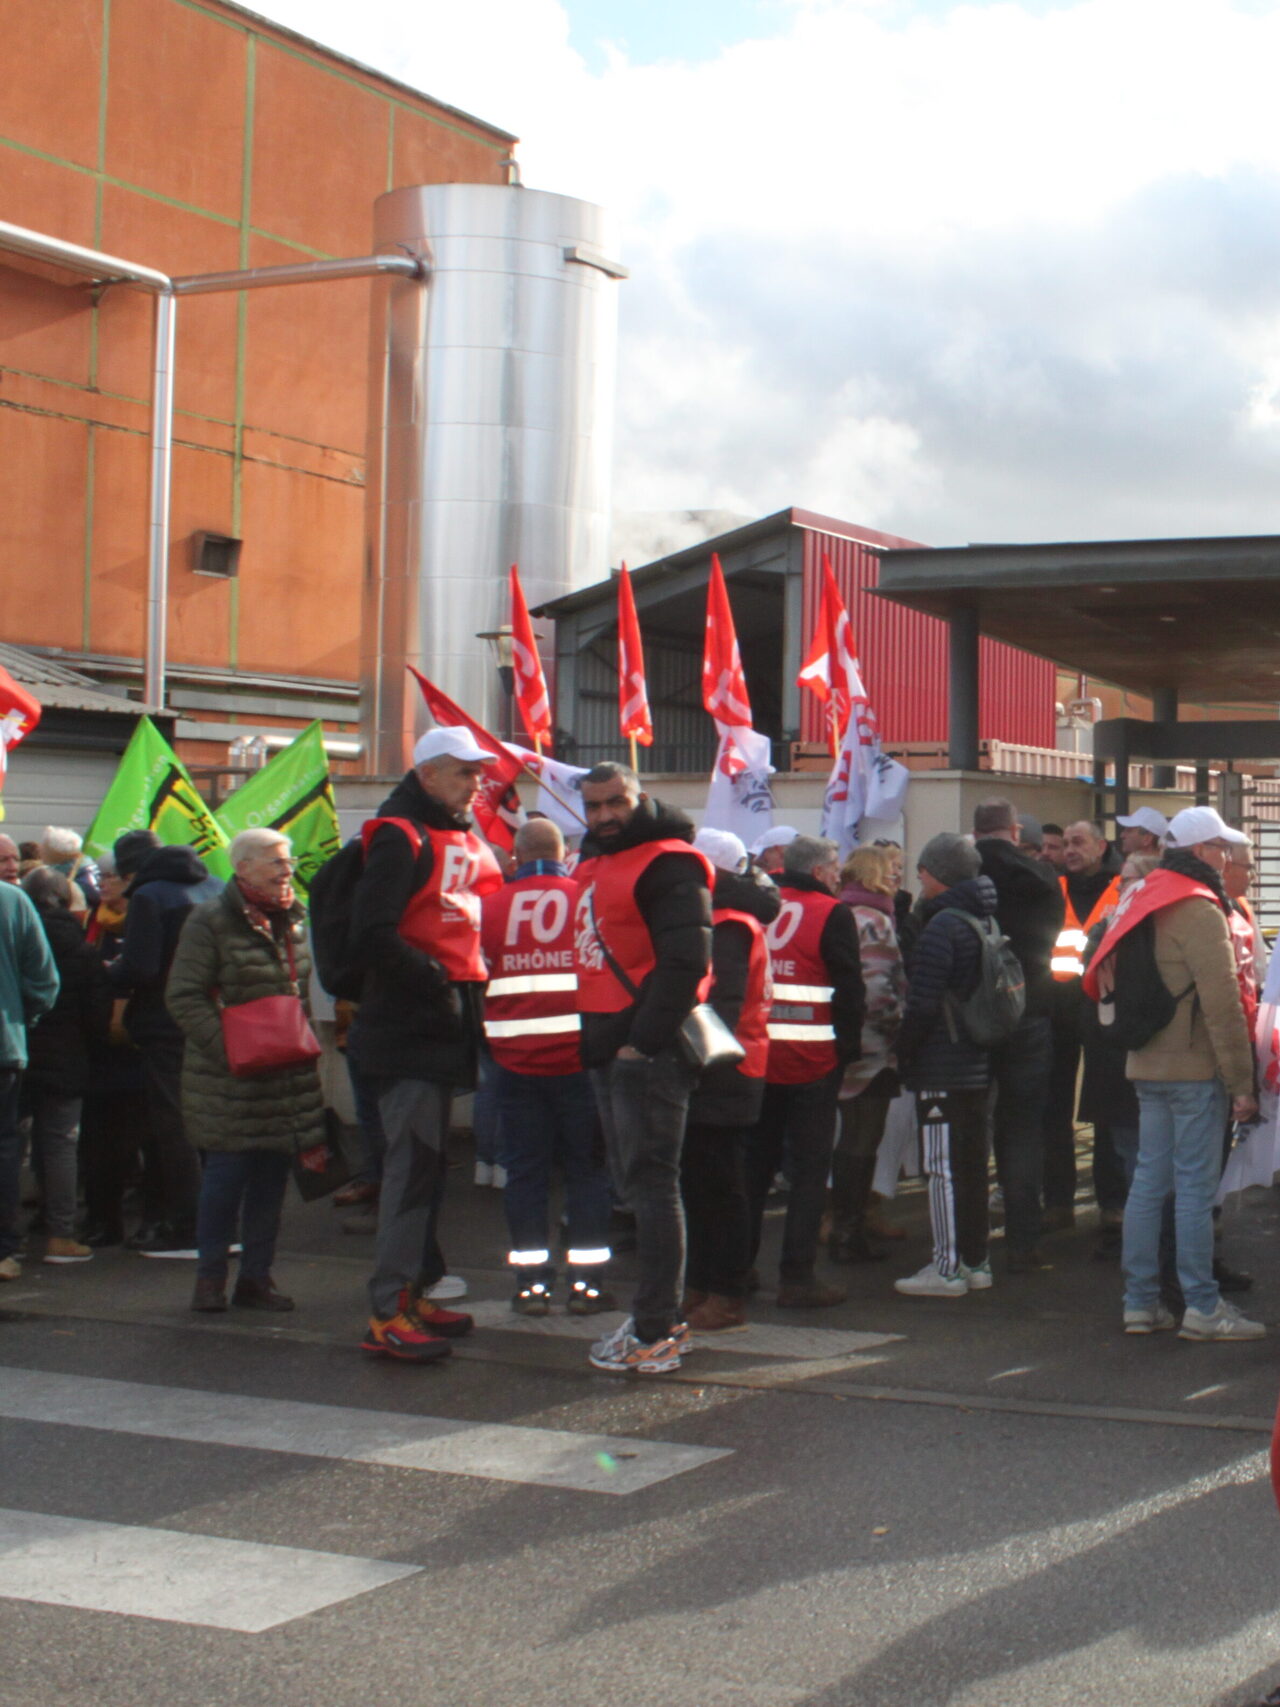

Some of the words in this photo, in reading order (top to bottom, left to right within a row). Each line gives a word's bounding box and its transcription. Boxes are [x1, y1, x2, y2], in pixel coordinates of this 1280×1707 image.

[504, 889, 569, 946] FO
[767, 900, 804, 950] O
[502, 948, 574, 971] RHÔNE
